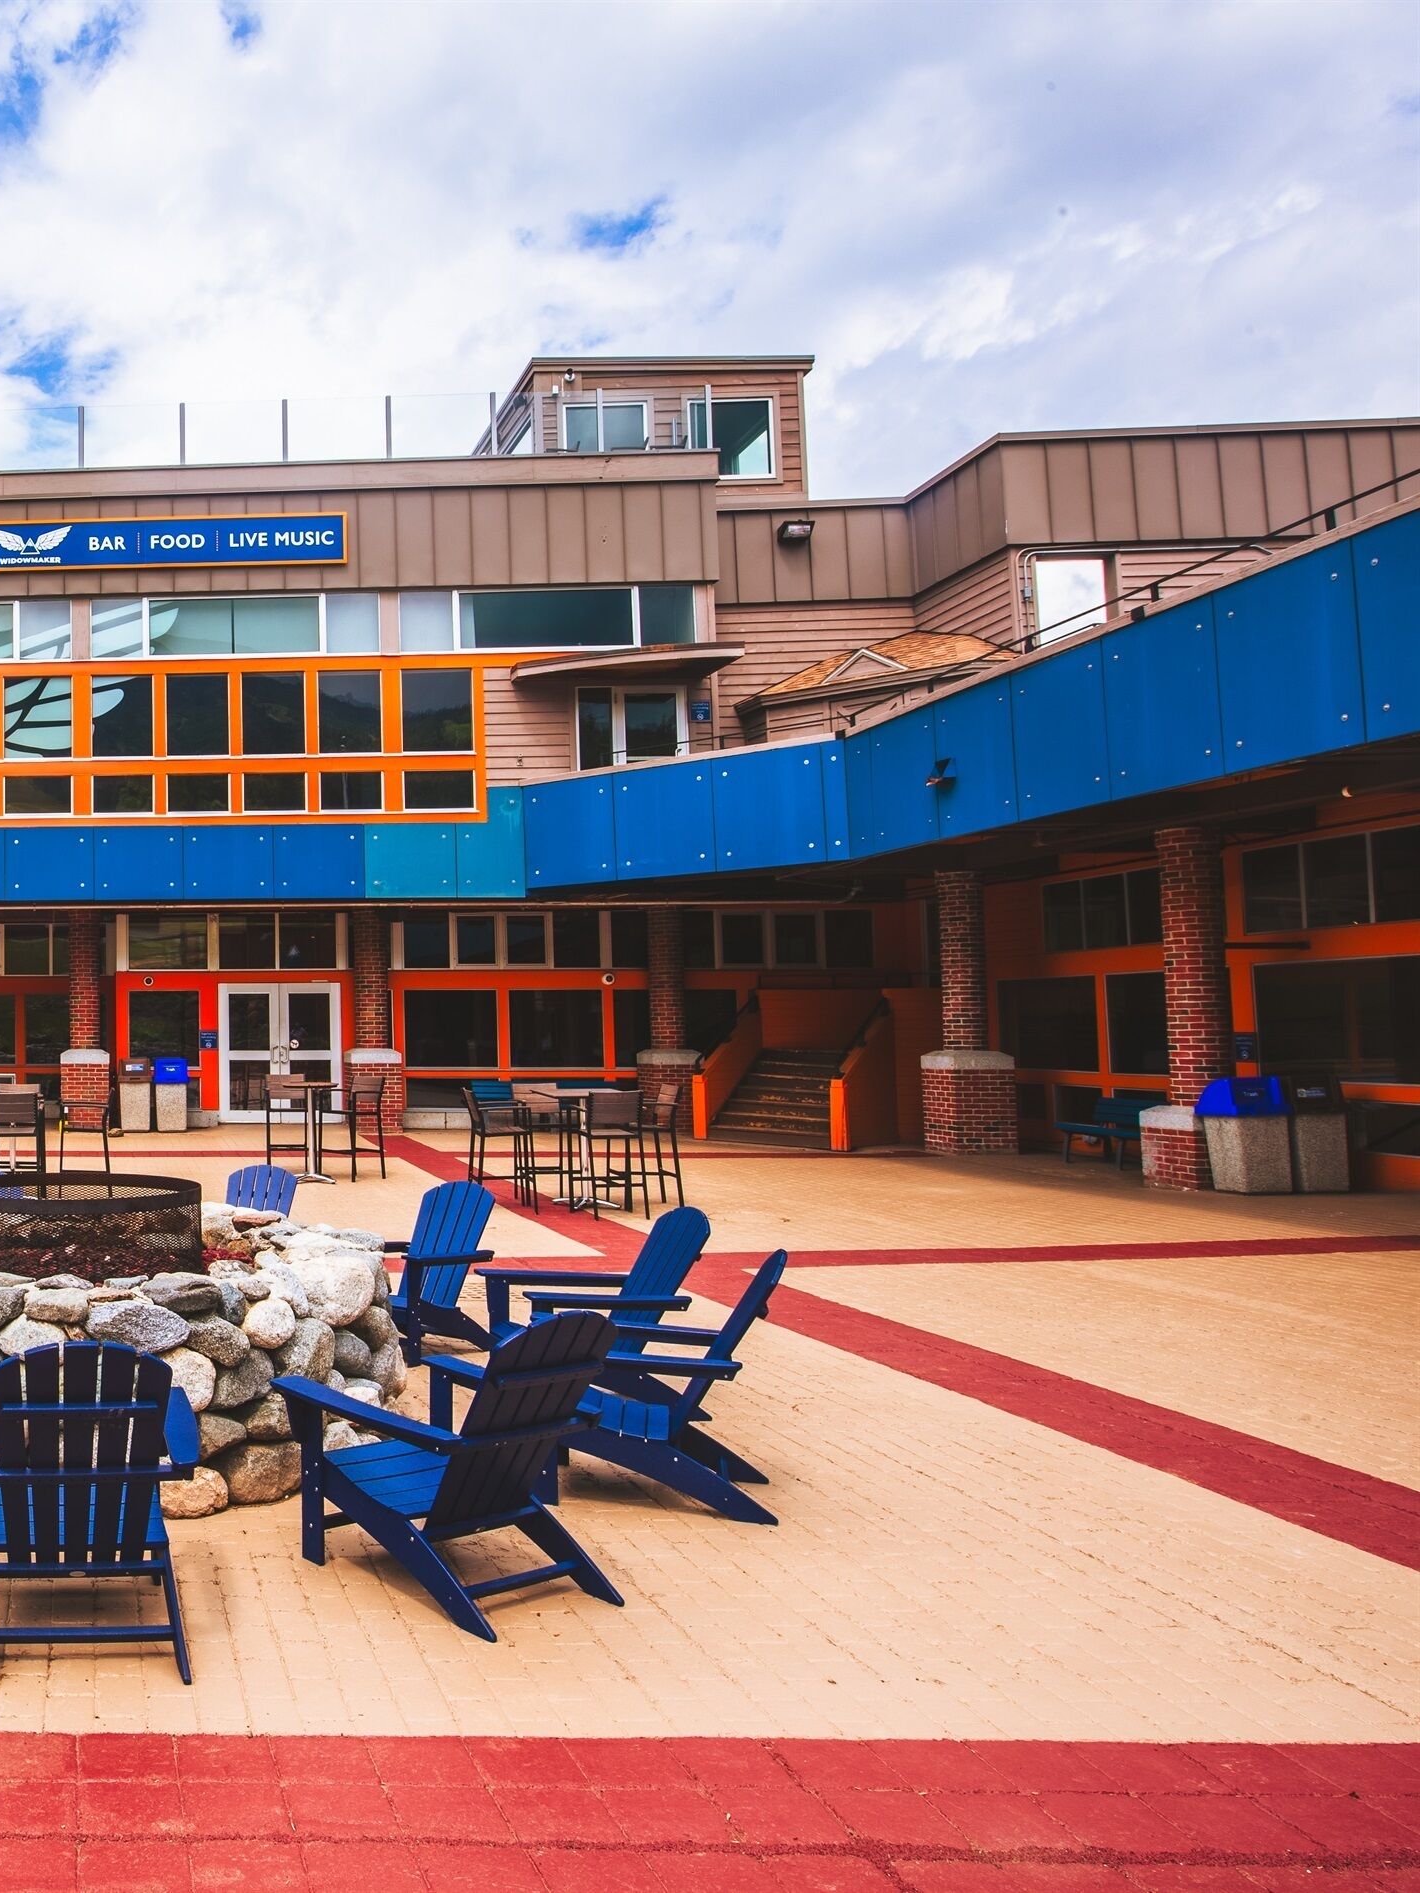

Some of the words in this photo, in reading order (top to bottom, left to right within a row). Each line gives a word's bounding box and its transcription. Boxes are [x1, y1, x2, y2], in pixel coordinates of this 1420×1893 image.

[88, 536, 126, 551] BAR
[150, 534, 206, 549] FOOD
[229, 532, 268, 547] LIVE
[274, 530, 335, 546] MUSIC
[0, 556, 62, 565] WIDOWMAKER
